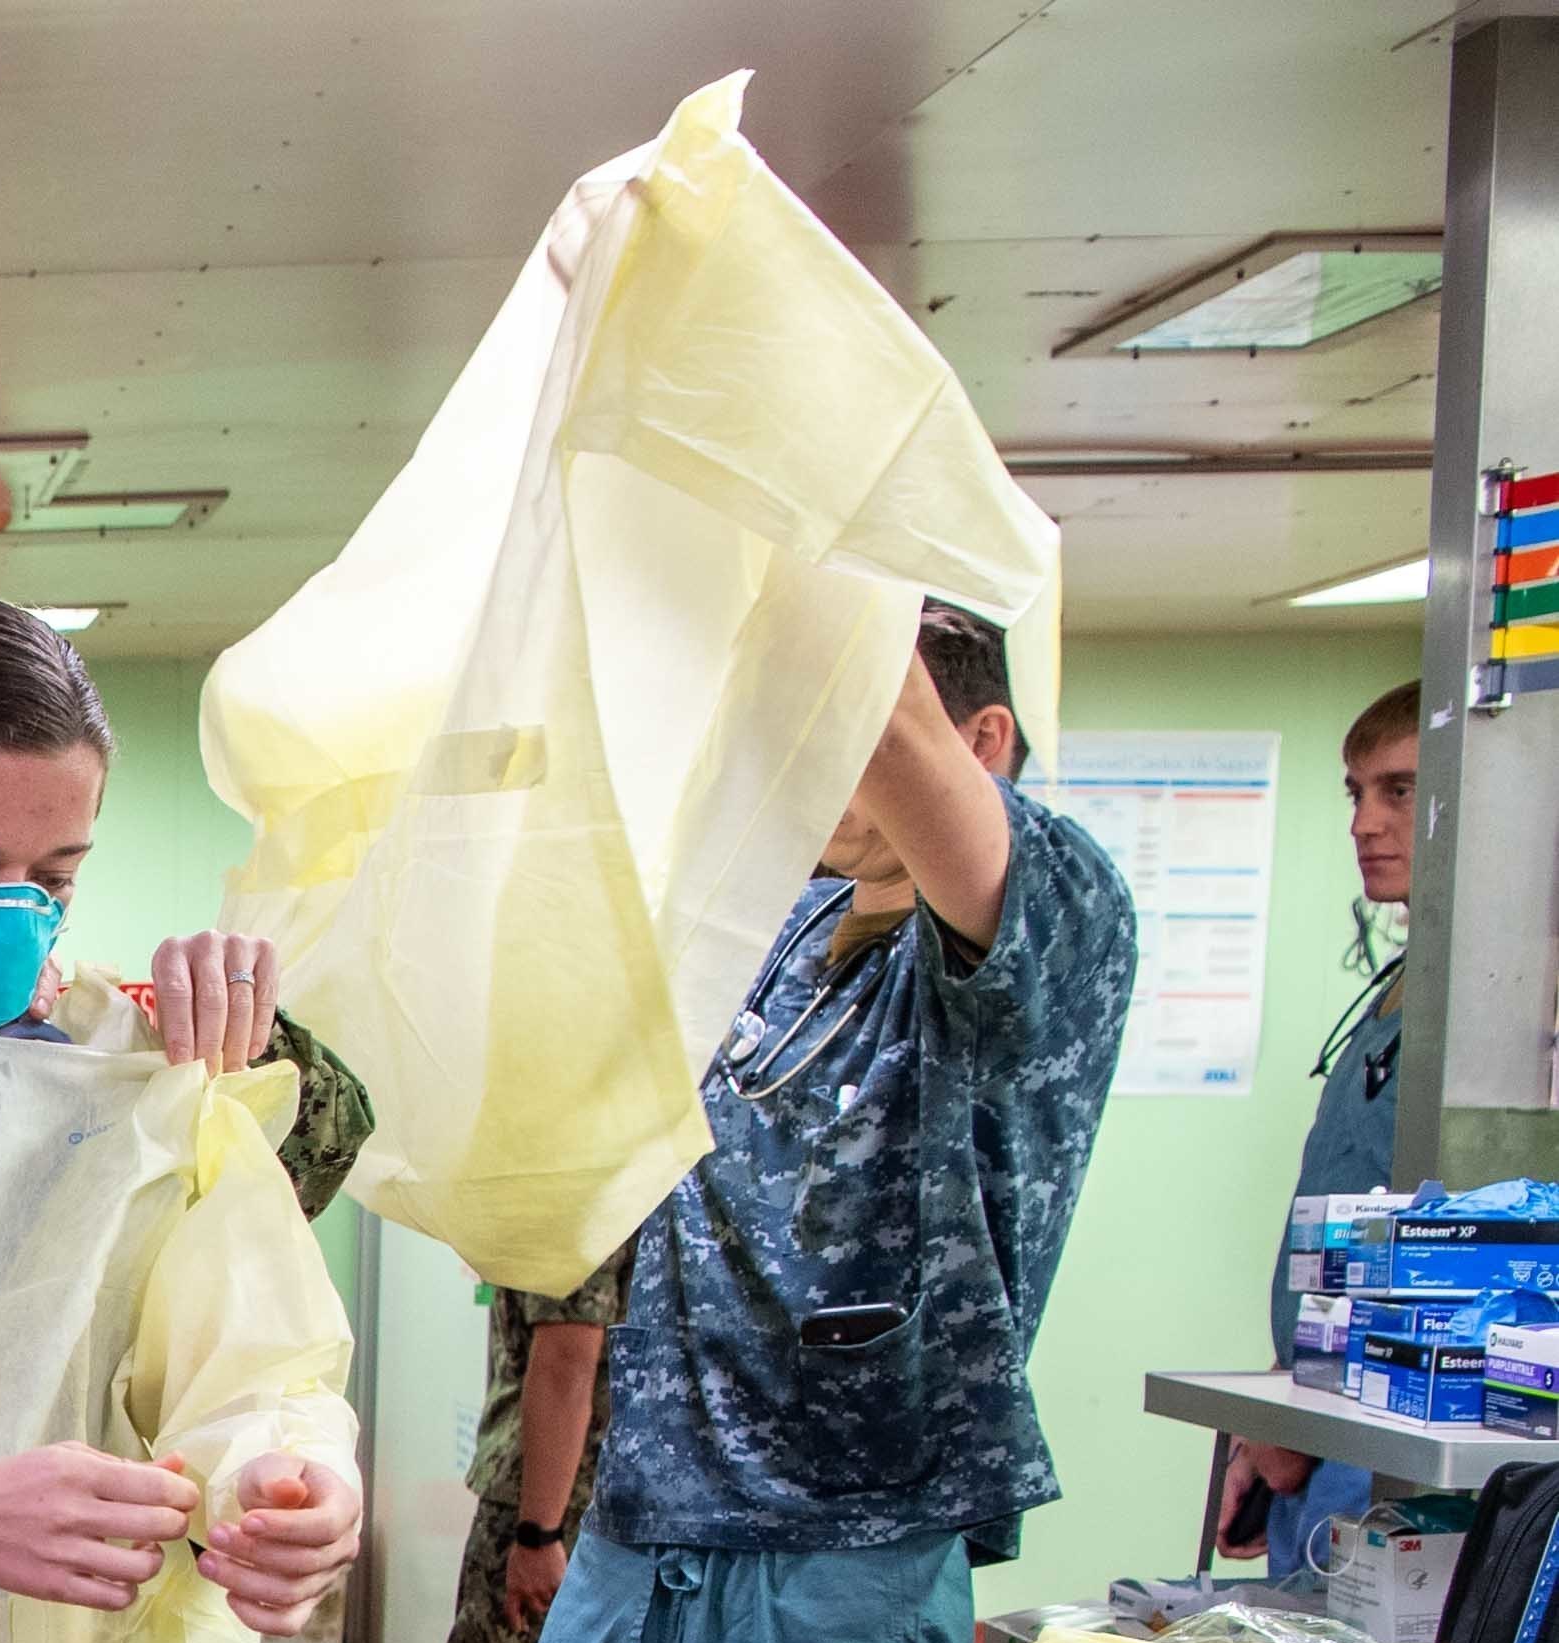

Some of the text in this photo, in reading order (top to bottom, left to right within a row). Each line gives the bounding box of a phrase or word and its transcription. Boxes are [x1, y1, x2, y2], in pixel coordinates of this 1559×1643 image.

[1459, 1226, 1477, 1238] XP
[1423, 1319, 1452, 1332] Flex
[1545, 1372, 1553, 1386] S
[1398, 1540, 1422, 1552] 3M
